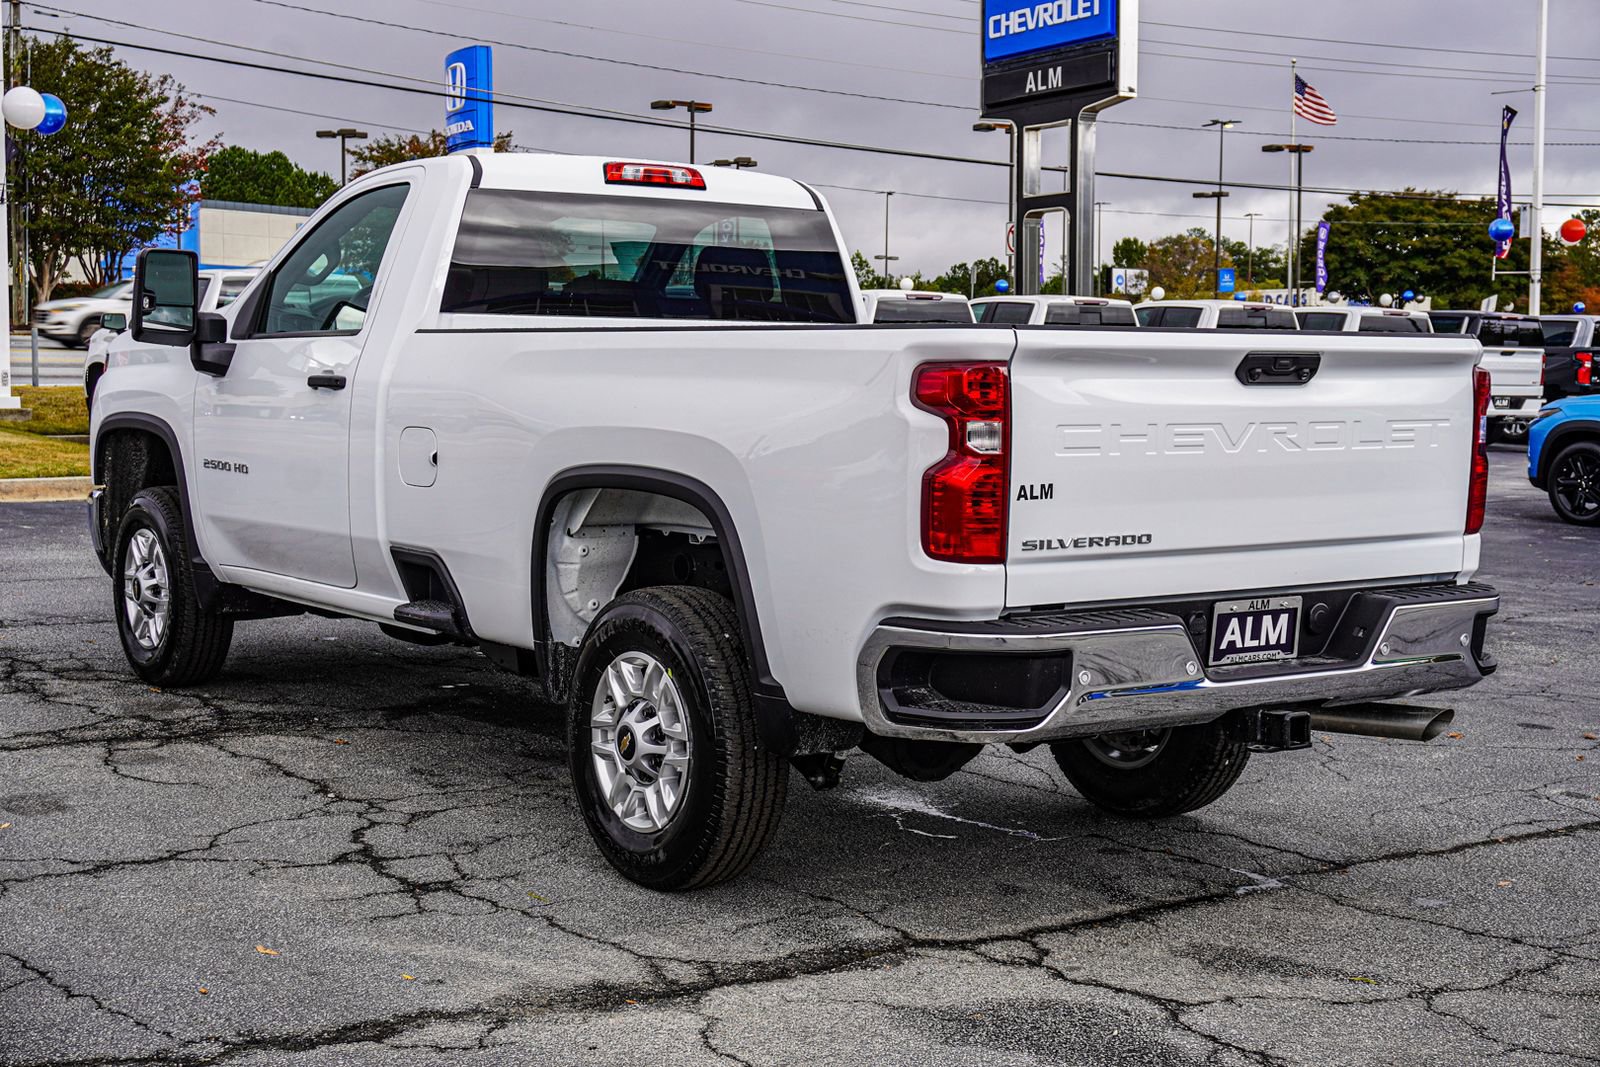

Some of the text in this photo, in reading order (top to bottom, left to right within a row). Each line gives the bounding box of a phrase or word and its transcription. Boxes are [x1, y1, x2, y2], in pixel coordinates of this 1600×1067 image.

[988, 0, 1100, 39] CHEVROLET
[1025, 66, 1062, 93] ALM
[1055, 418, 1450, 456] CHEVROLET
[203, 458, 249, 474] 2500 HD
[1016, 483, 1054, 500] ALM
[1021, 533, 1152, 551] SILVERADO
[1248, 600, 1269, 610] ALM
[1219, 613, 1289, 650] ALM
[1230, 652, 1277, 663] ALMCARS.COM
